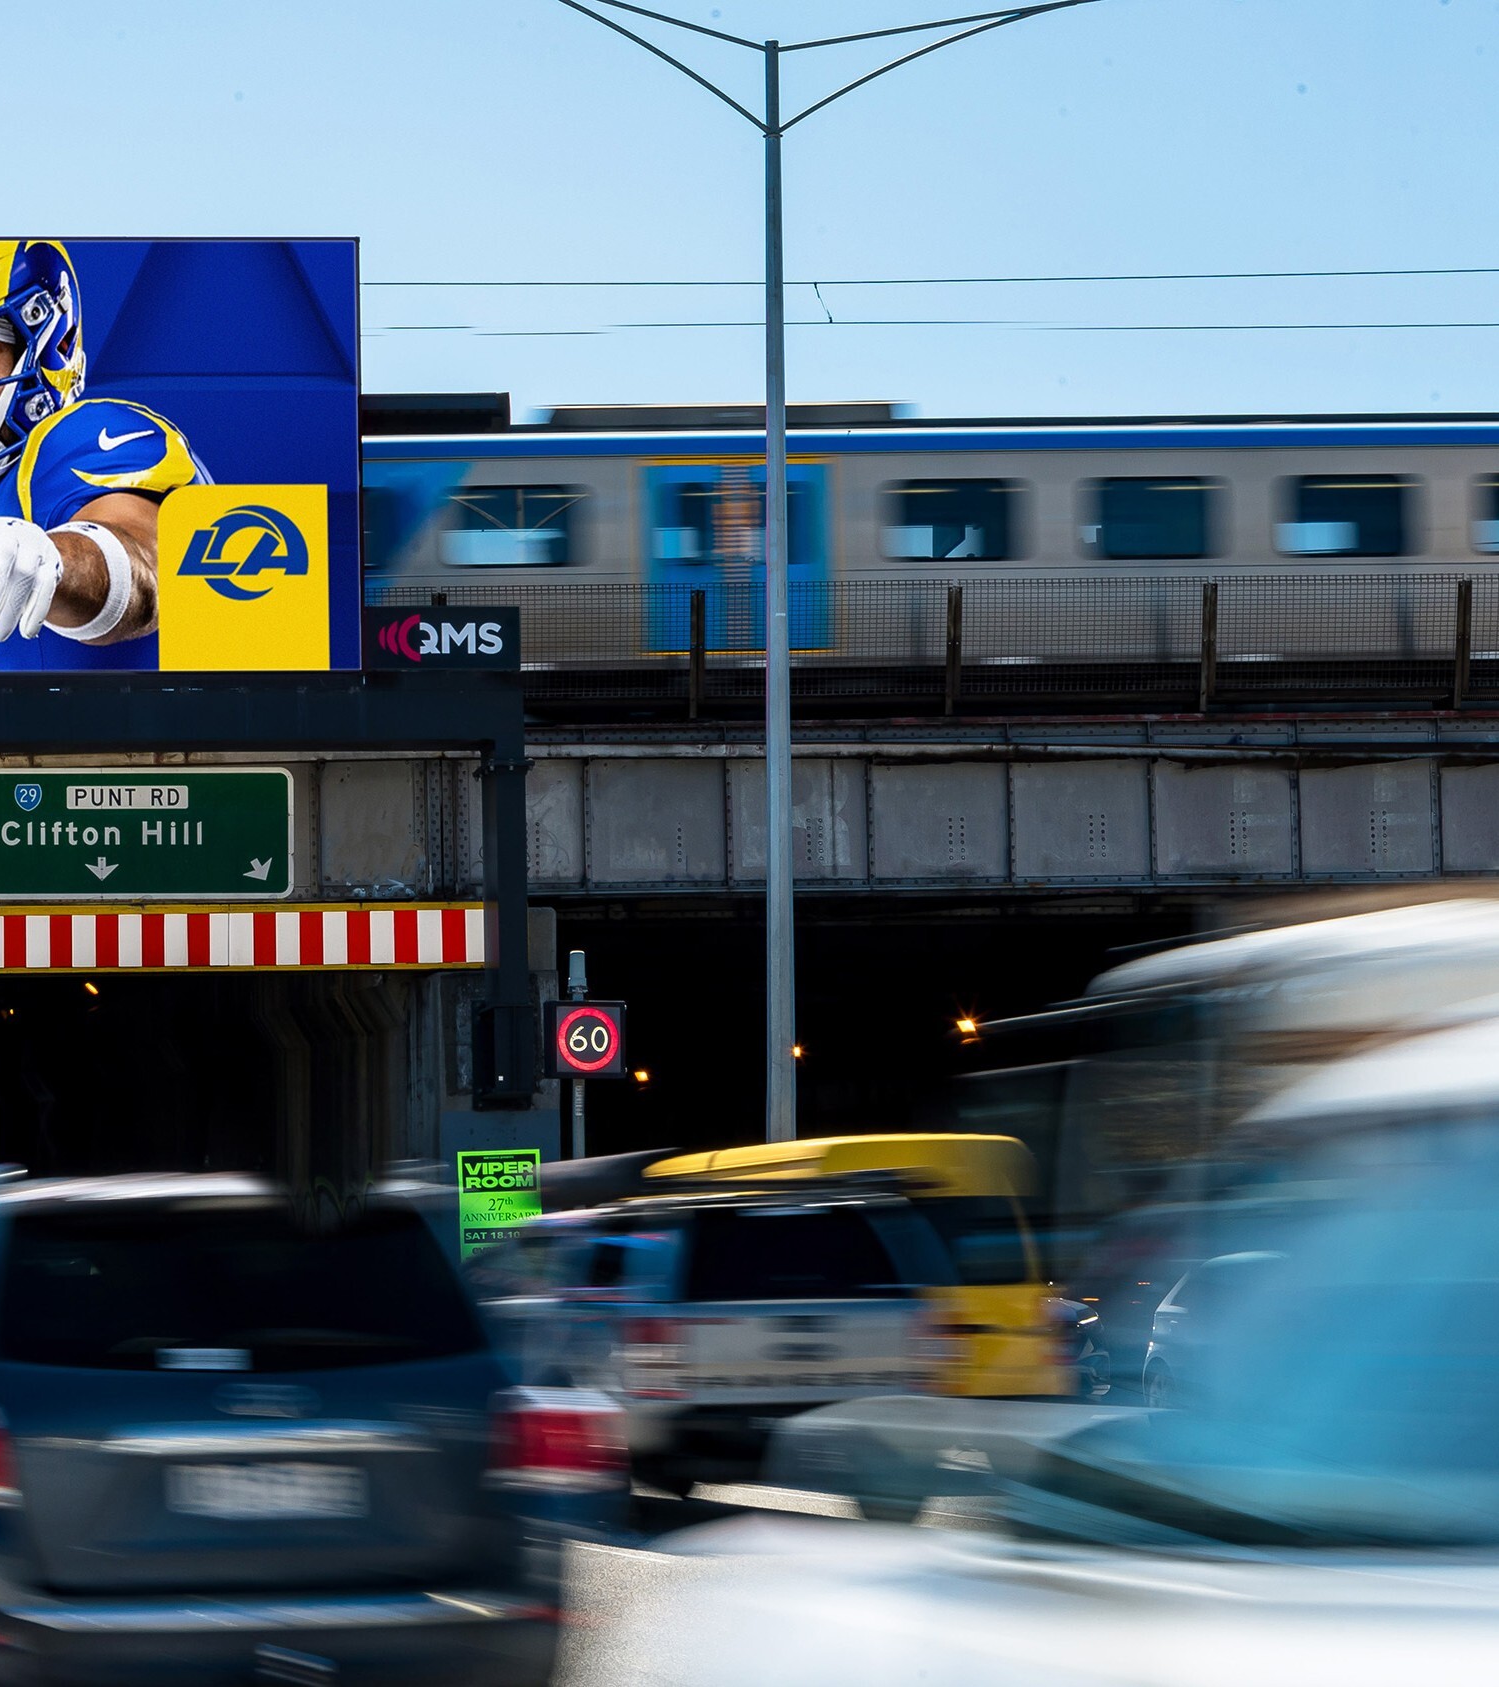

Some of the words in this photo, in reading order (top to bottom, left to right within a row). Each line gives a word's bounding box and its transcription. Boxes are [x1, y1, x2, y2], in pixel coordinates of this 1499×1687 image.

[398, 619, 503, 656] QMS
[19, 788, 37, 803] 29
[74, 788, 136, 806] PUNT
[151, 788, 180, 806] RD
[1, 821, 120, 846] Clifton
[142, 821, 202, 845] Hill
[569, 1025, 609, 1053] 60
[464, 1161, 533, 1175] VIPER
[465, 1175, 533, 1189] ROOM
[488, 1197, 513, 1211] 27th
[465, 1232, 487, 1240] SAT
